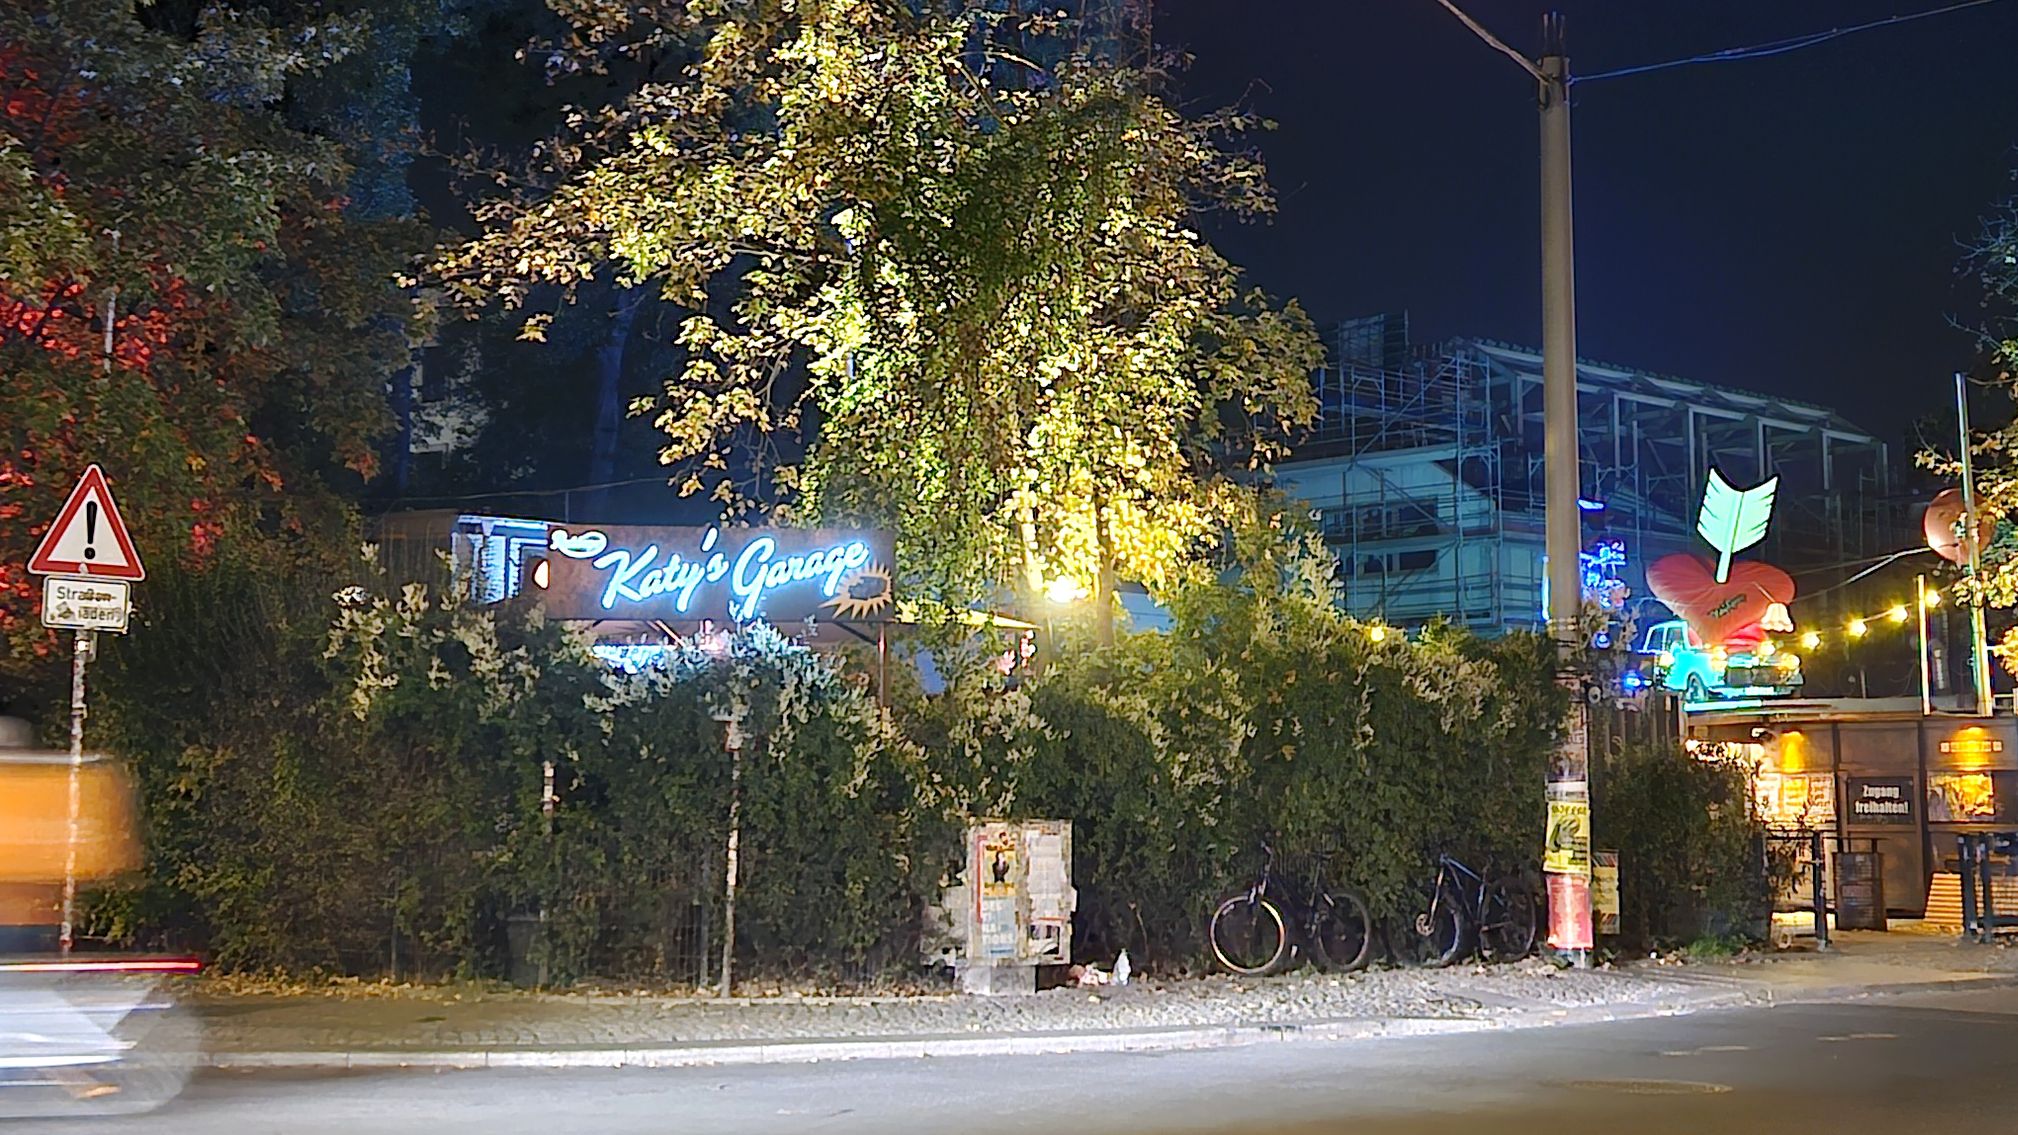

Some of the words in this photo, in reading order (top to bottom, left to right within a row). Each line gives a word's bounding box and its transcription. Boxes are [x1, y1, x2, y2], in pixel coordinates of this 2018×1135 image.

[595, 527, 729, 612] Katy's
[731, 537, 869, 619] Garage
[1862, 784, 1900, 799] Zugang
[1855, 800, 1909, 814] freihalten!
